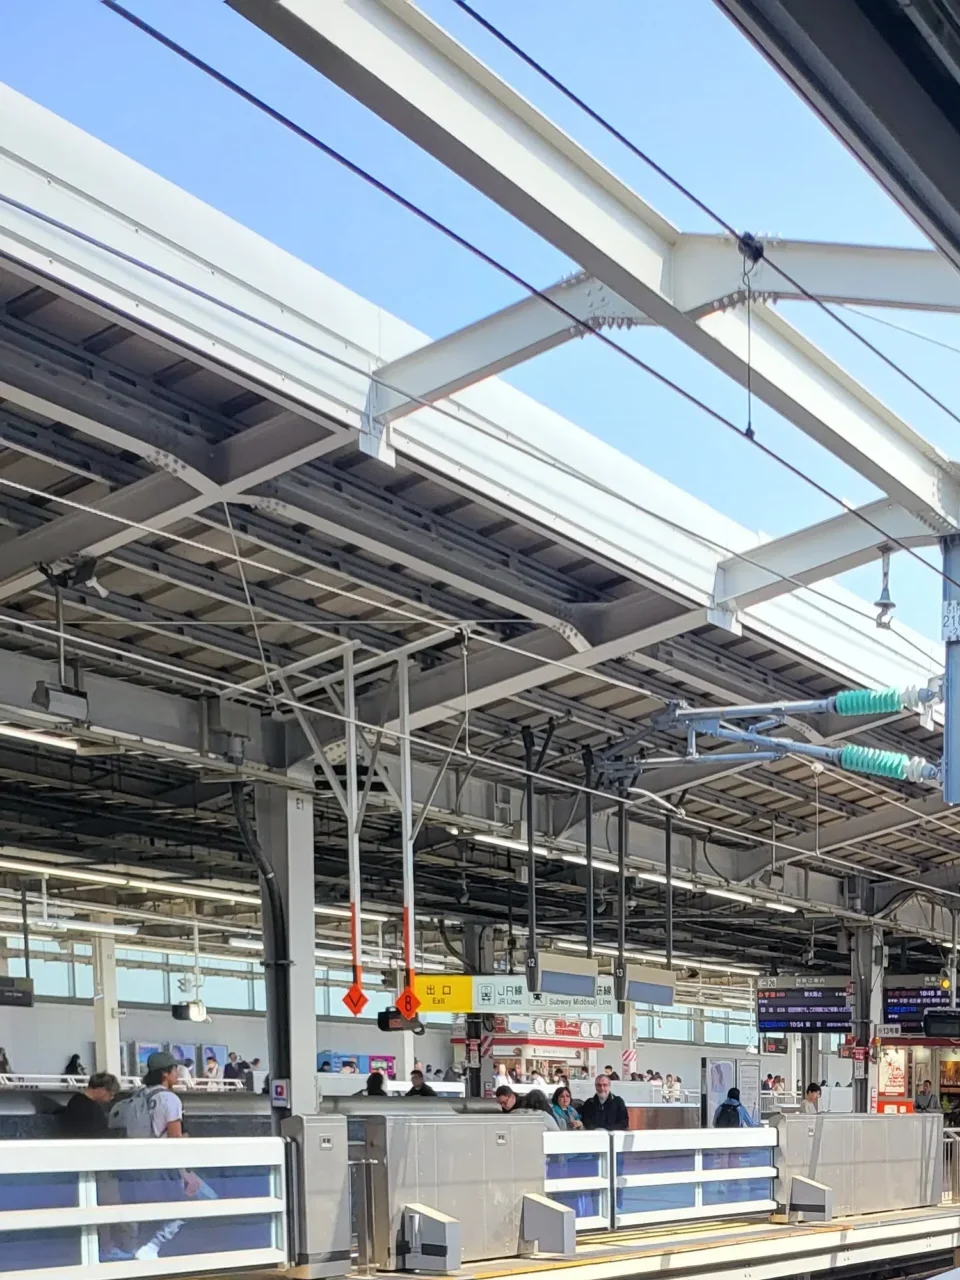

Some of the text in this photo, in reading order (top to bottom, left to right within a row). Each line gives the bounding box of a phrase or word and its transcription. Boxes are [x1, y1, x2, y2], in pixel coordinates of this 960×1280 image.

[527, 958, 536, 967] 12
[616, 968, 624, 977] 13
[768, 979, 776, 987] 26
[426, 984, 451, 995] 出口
[498, 985, 523, 996] JR線
[404, 995, 412, 1012] 8
[432, 997, 446, 1005] Exit
[549, 998, 572, 1007] Subway
[599, 998, 612, 1006] Line
